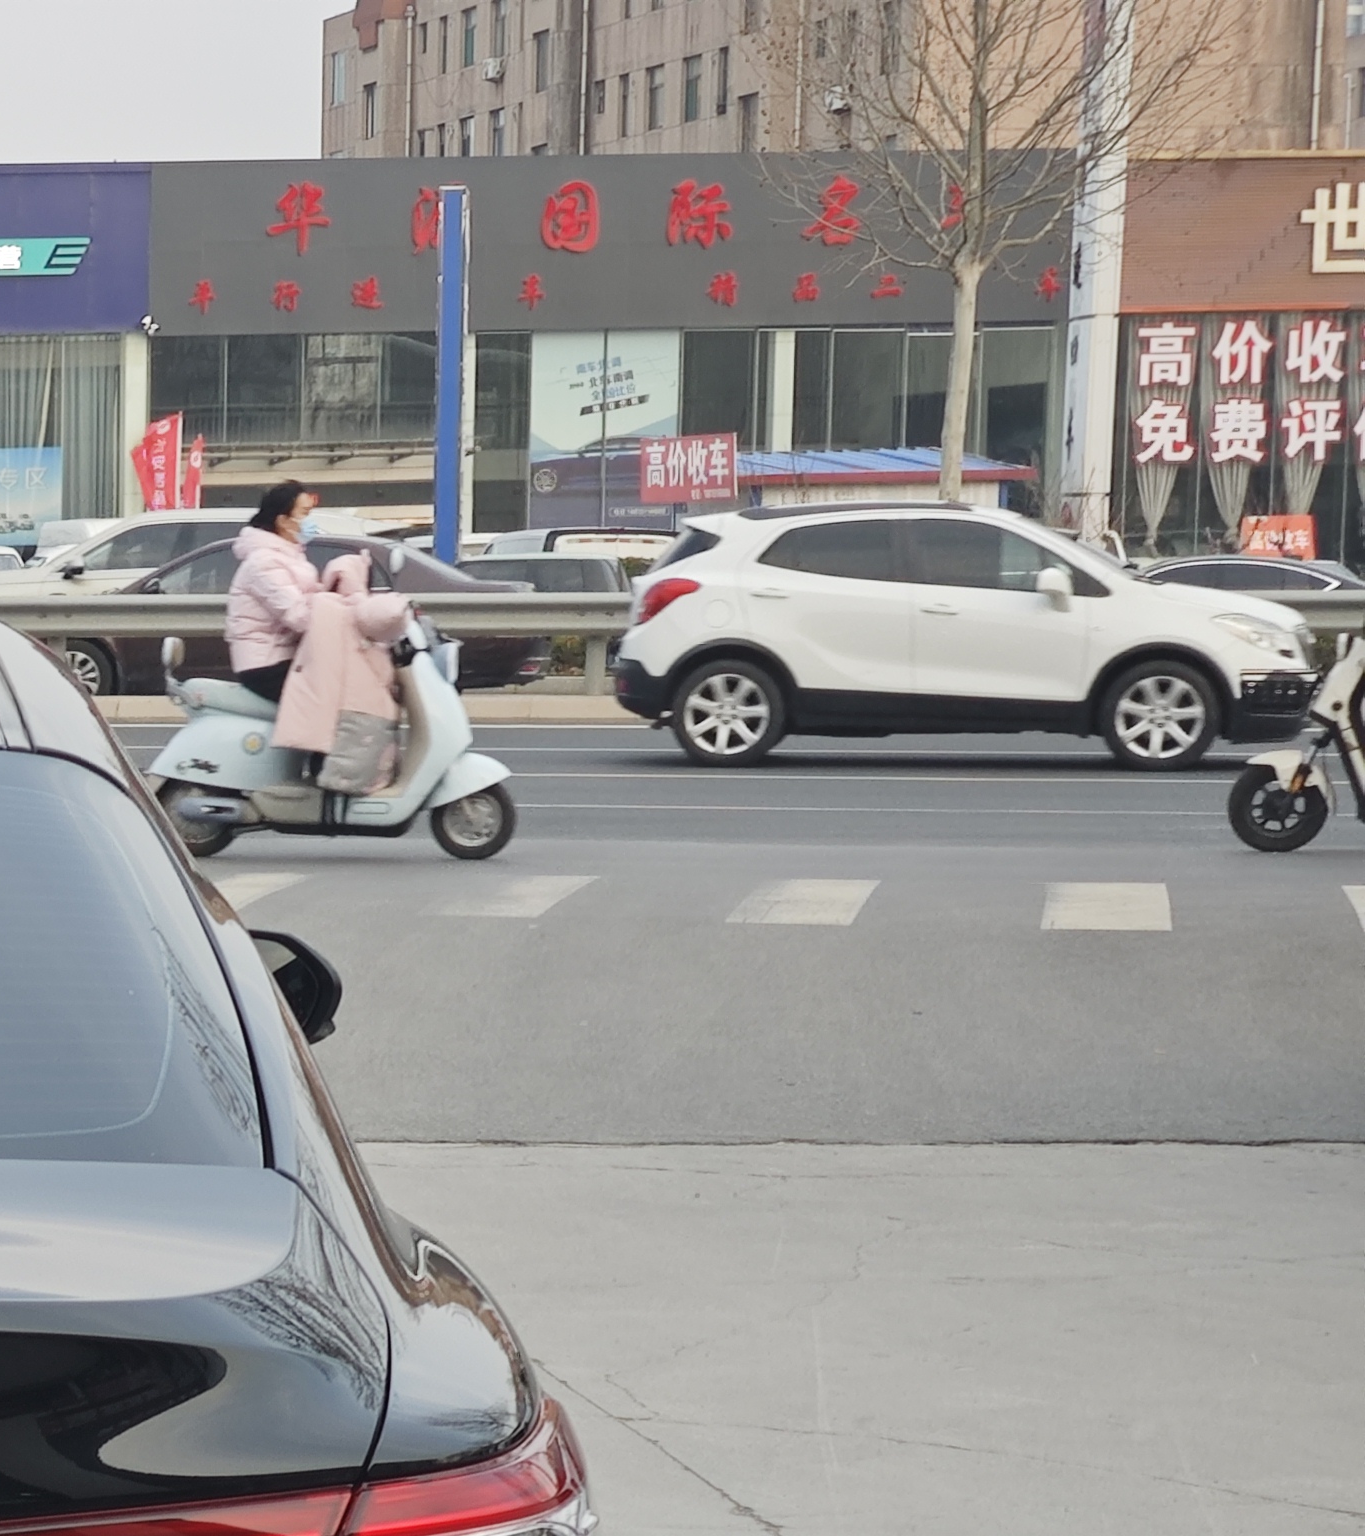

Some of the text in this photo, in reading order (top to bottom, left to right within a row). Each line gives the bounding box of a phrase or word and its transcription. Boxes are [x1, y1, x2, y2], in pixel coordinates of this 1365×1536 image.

[1300, 182, 1365, 274] 世
[189, 266, 1062, 314] 平行进车 精品二车
[1137, 319, 1365, 387] 高价收
[645, 438, 729, 488] 高价收车
